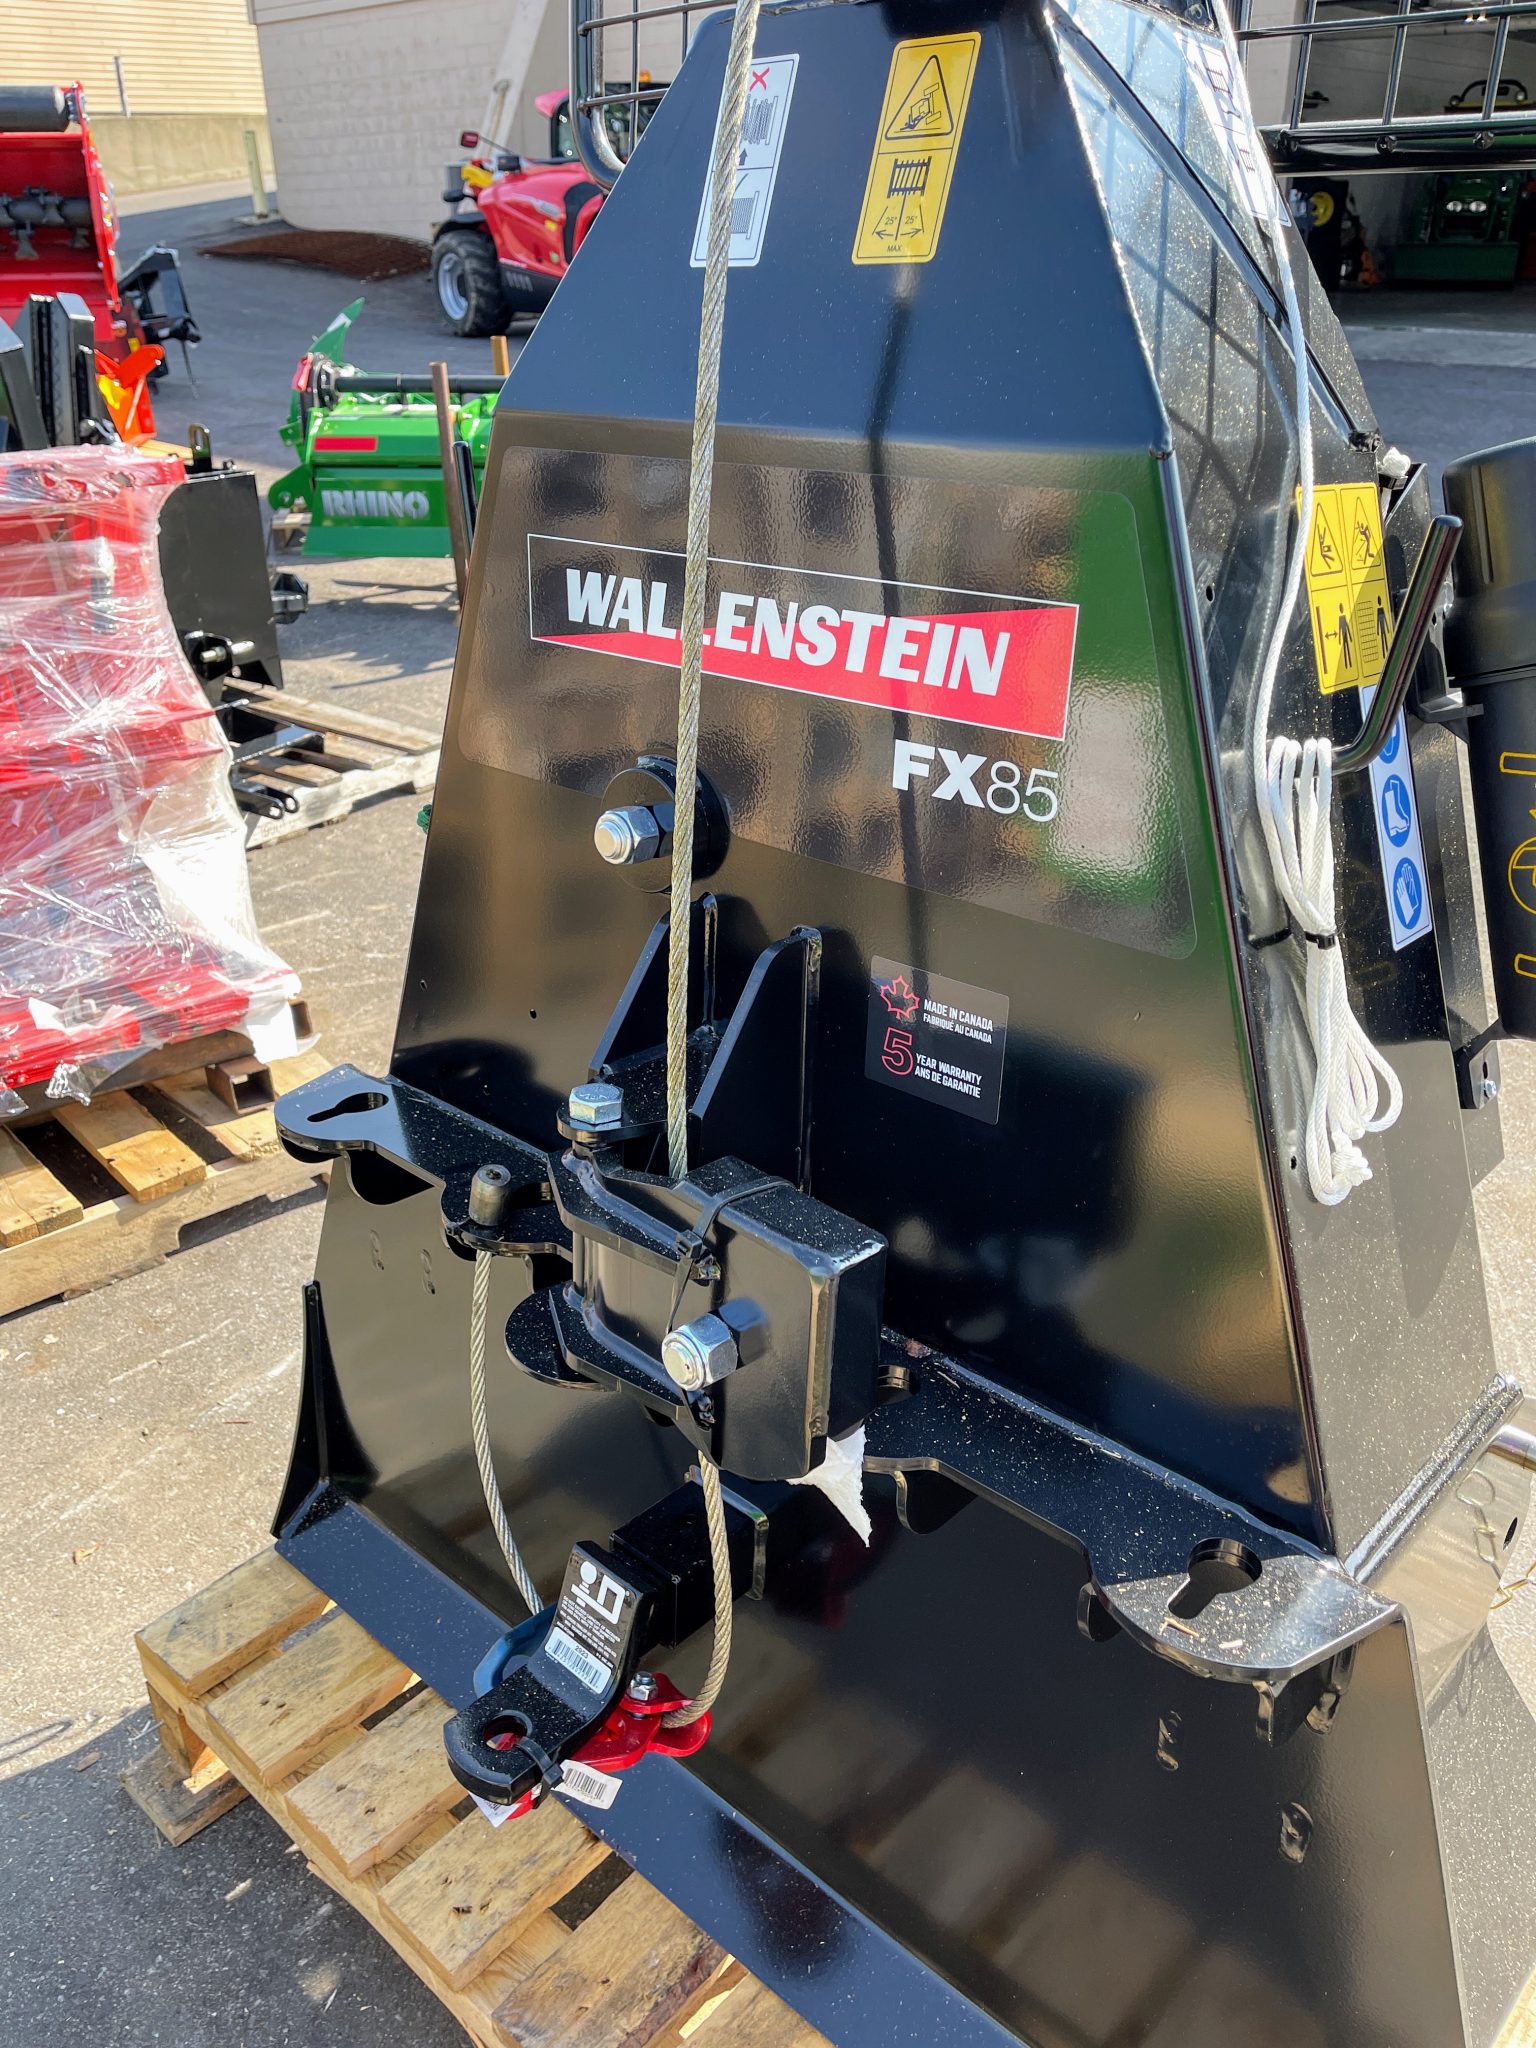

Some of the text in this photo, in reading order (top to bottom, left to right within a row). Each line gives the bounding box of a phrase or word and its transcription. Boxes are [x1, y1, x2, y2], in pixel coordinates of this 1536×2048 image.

[886, 244, 902, 253] MAX
[320, 488, 430, 520] RHINO
[566, 568, 1010, 696] WALENSTEIN
[892, 738, 1059, 822] FX85
[923, 999, 993, 1032] MADE IN CANADA
[923, 1013, 992, 1044] FABRIQUÉ AU CANADA
[881, 1027, 914, 1075] 5
[914, 1065, 981, 1098] ANS DE GARANTIE
[915, 1053, 983, 1086] YEAR WARRANTY
